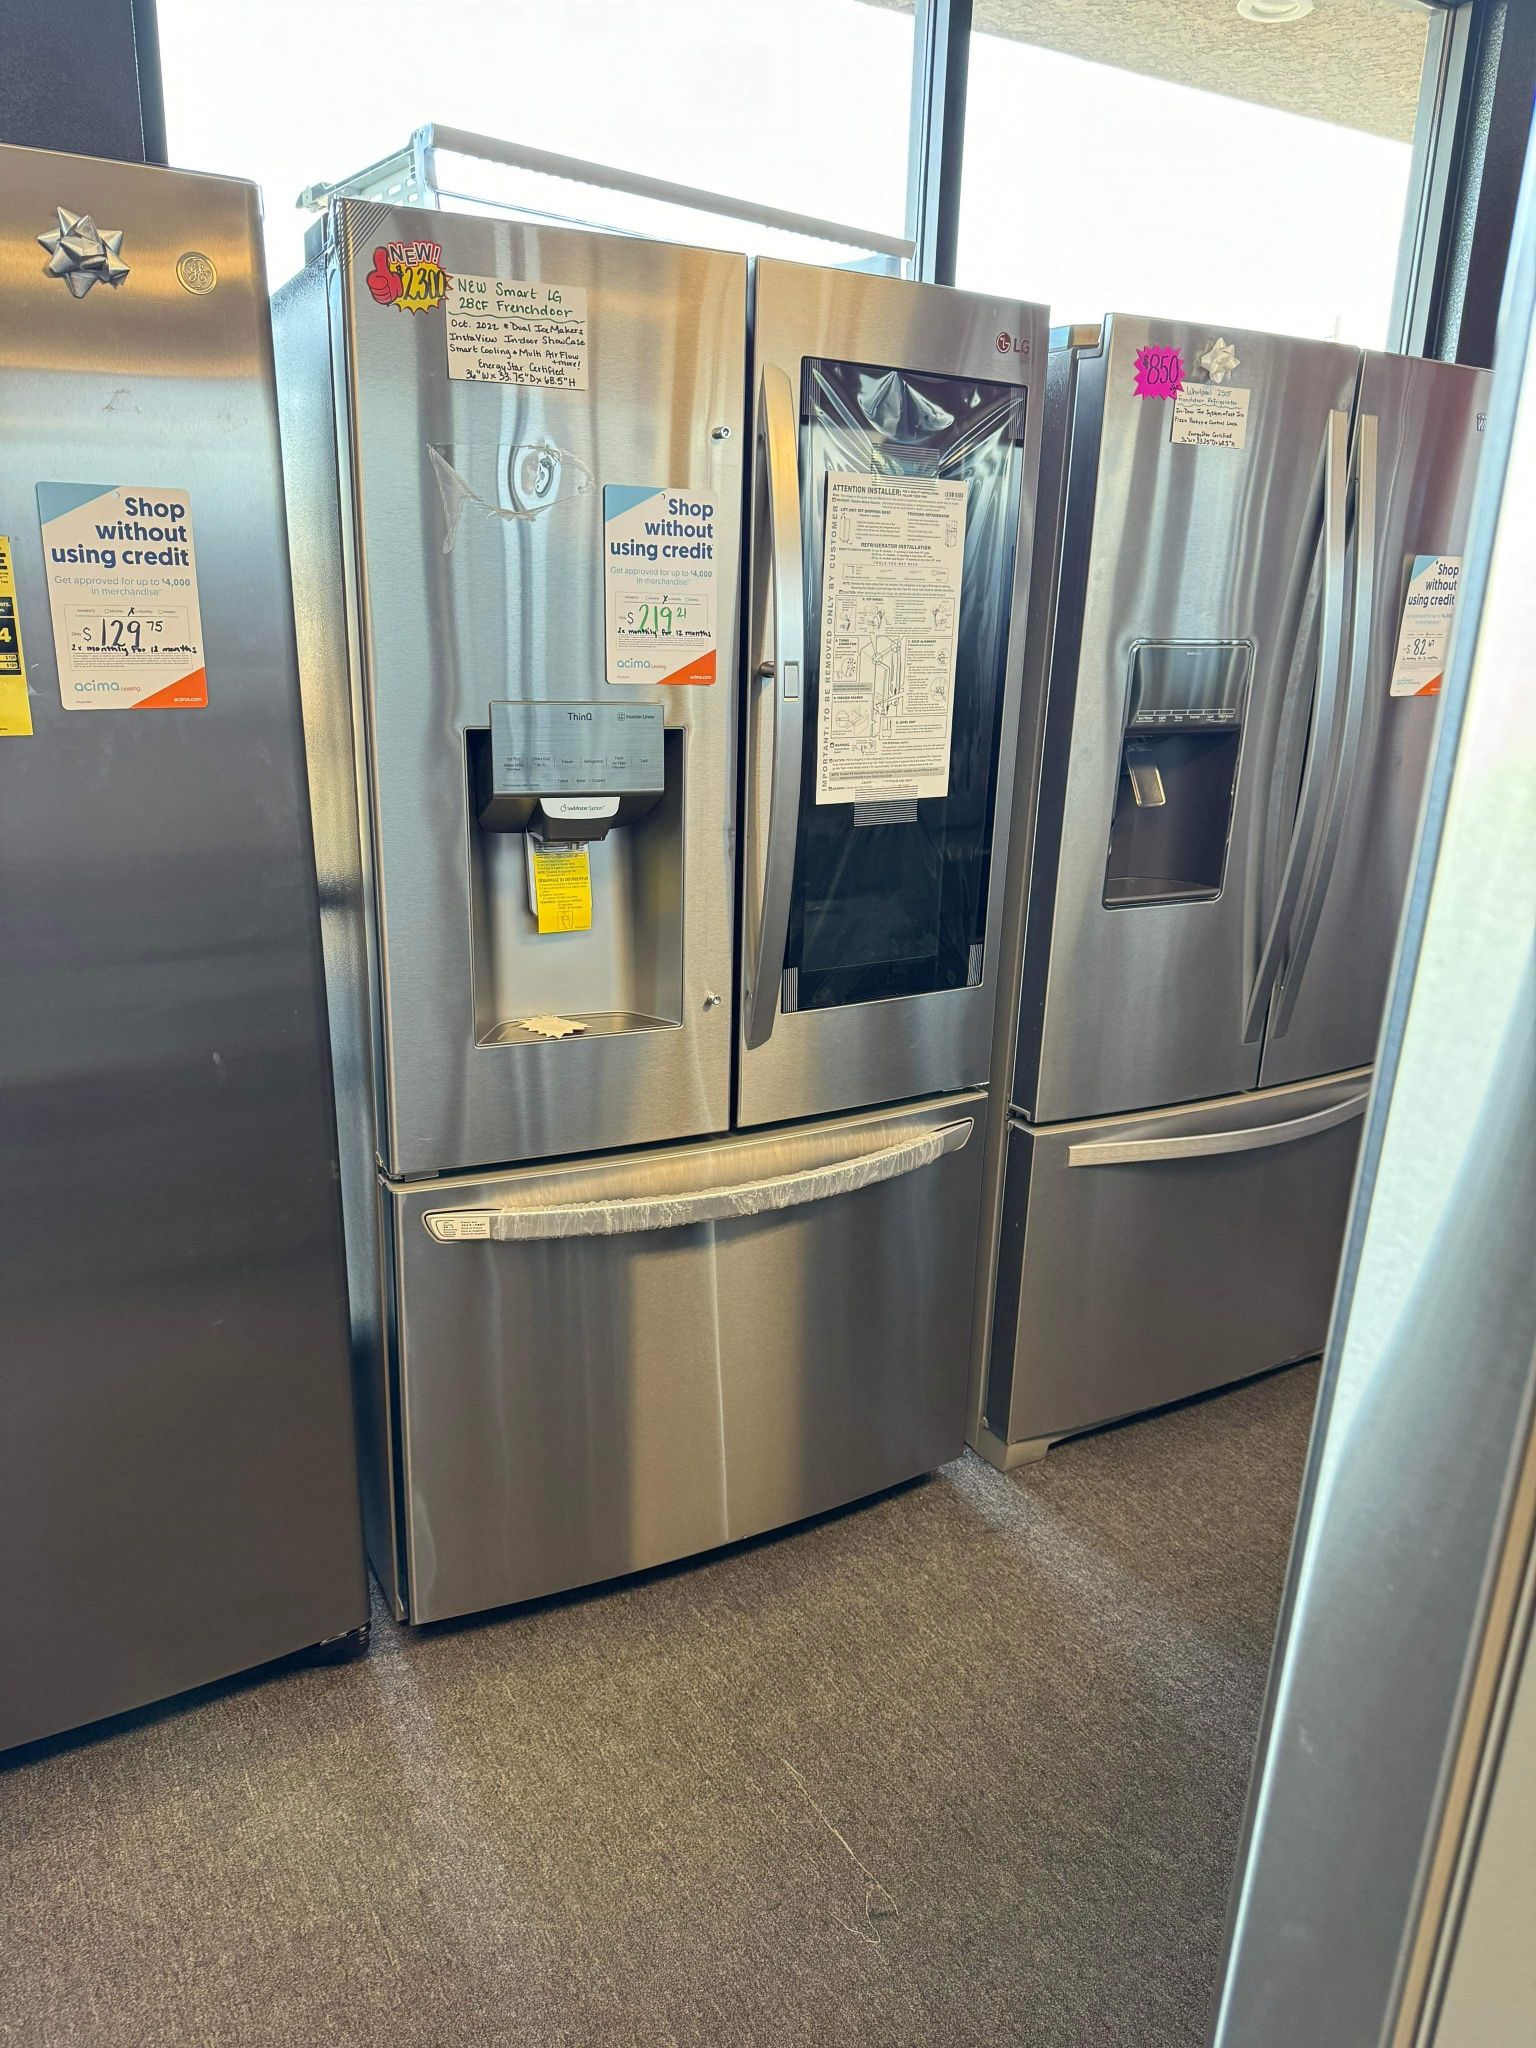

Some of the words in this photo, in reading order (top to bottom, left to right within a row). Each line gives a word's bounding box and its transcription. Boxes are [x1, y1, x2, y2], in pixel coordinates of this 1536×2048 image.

[389, 243, 440, 266] NEW!
[458, 279, 487, 294] NEW
[496, 282, 538, 299] Smart
[548, 290, 562, 304] LG
[459, 297, 489, 310] 28CF
[497, 301, 573, 317] Frenchdoor
[451, 319, 471, 328] Oct.
[476, 321, 499, 330] 2022
[449, 333, 498, 343] InstaView
[450, 344, 478, 353] Smart
[481, 346, 512, 359] Cooling
[519, 349, 541, 357] Multi
[1013, 338, 1030, 354] LG
[530, 363, 565, 376] Certified
[1143, 354, 1179, 384] $850
[832, 484, 866, 494] ATTENTION
[867, 487, 902, 496] INSTALLER:
[125, 497, 185, 522] Shop
[669, 499, 714, 521] Shop
[96, 521, 188, 543] without
[644, 520, 714, 539] without
[829, 505, 839, 569] CUSTOMER
[51, 544, 117, 569] using
[611, 539, 658, 561] using
[625, 567, 658, 576] approved
[660, 568, 670, 576] for
[671, 570, 680, 578] up
[1438, 564, 1460, 579] Shop
[55, 576, 71, 584] Get
[75, 577, 119, 586] approved
[121, 577, 134, 585] for
[162, 579, 191, 587] $4,000
[829, 575, 835, 589] BY
[1425, 579, 1458, 591] without
[1408, 594, 1429, 608] using
[1431, 594, 1456, 606] credit
[627, 611, 634, 625] $
[83, 627, 92, 642] $
[101, 618, 141, 648] 129
[146, 620, 163, 633] 75
[628, 627, 658, 638] monthly
[685, 630, 712, 638] months
[87, 645, 129, 656] monthly
[131, 645, 146, 654] for
[162, 645, 198, 654] months
[1414, 639, 1426, 655] 82
[617, 658, 651, 669] acima
[825, 631, 833, 684] REMOVED
[74, 680, 120, 691] acima
[825, 688, 831, 700] BE
[568, 712, 593, 721] ThinQ
[824, 708, 830, 720] TO
